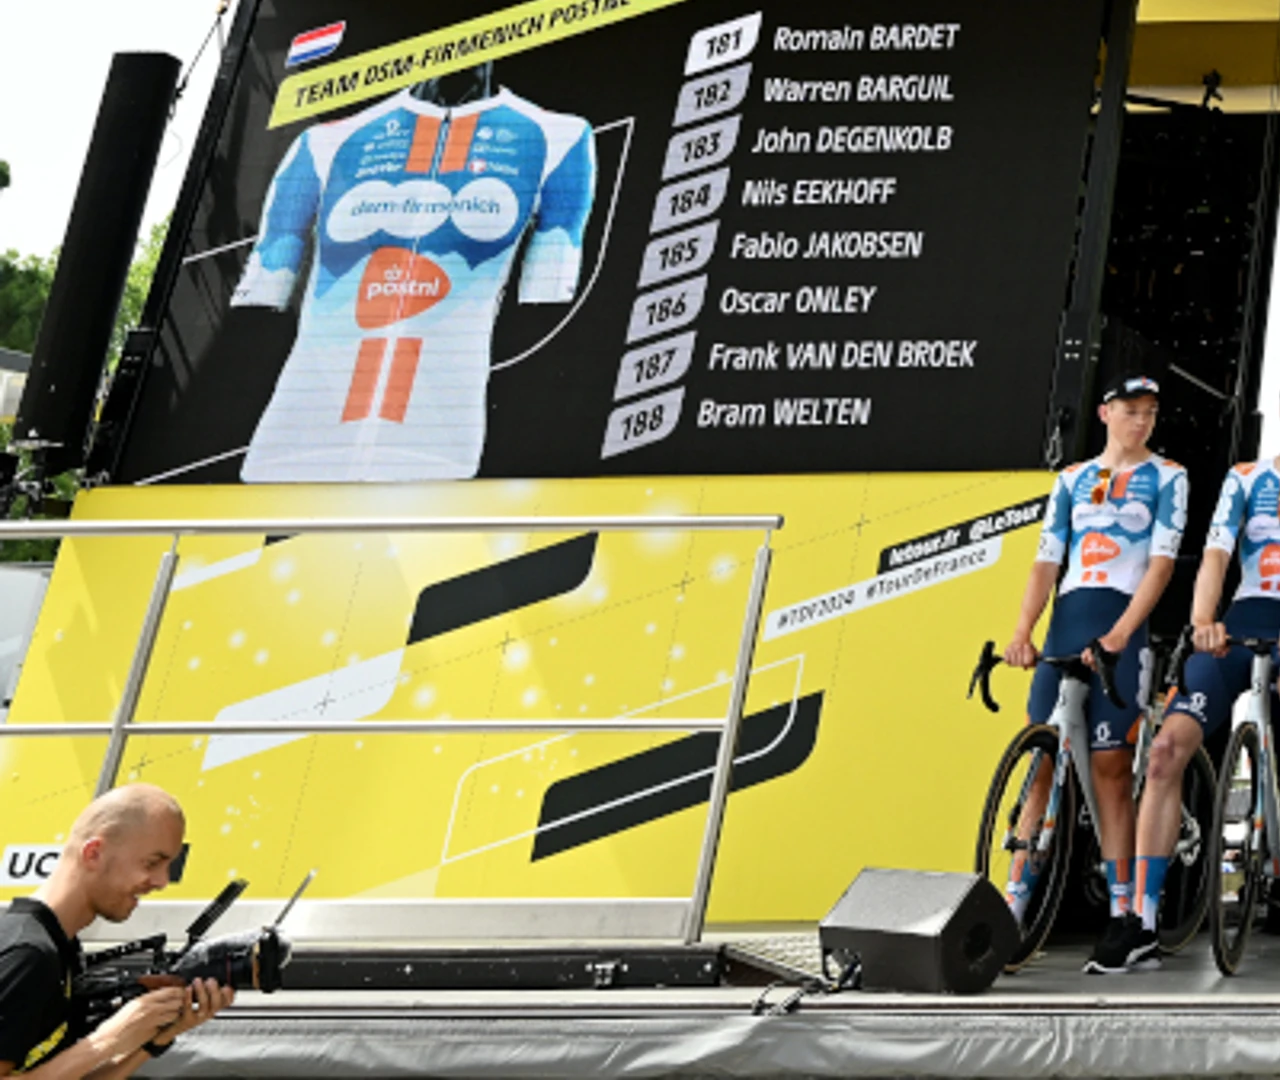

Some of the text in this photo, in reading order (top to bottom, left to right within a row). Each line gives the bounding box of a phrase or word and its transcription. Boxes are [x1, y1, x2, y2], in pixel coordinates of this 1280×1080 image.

[293, 73, 359, 109] TEAM
[362, 12, 546, 91] DSM-FIRMENICH
[706, 24, 961, 59] 181 Romain BARDET
[693, 75, 954, 110] 182 Warren BARGUIL
[682, 126, 953, 162] 183 John DEGENKOLB
[669, 178, 897, 216] 184 Nils EEKHOFF
[658, 231, 925, 271] 185 Fabio JAKOBSEN
[366, 277, 441, 301] postnl
[645, 286, 878, 326] 186 Oscar ONLEY
[632, 340, 977, 383] 187 Frank VAN DEN BROEK
[620, 398, 872, 441] 188 Bram WELTEN
[889, 502, 1042, 567] letour.fr @LeTour
